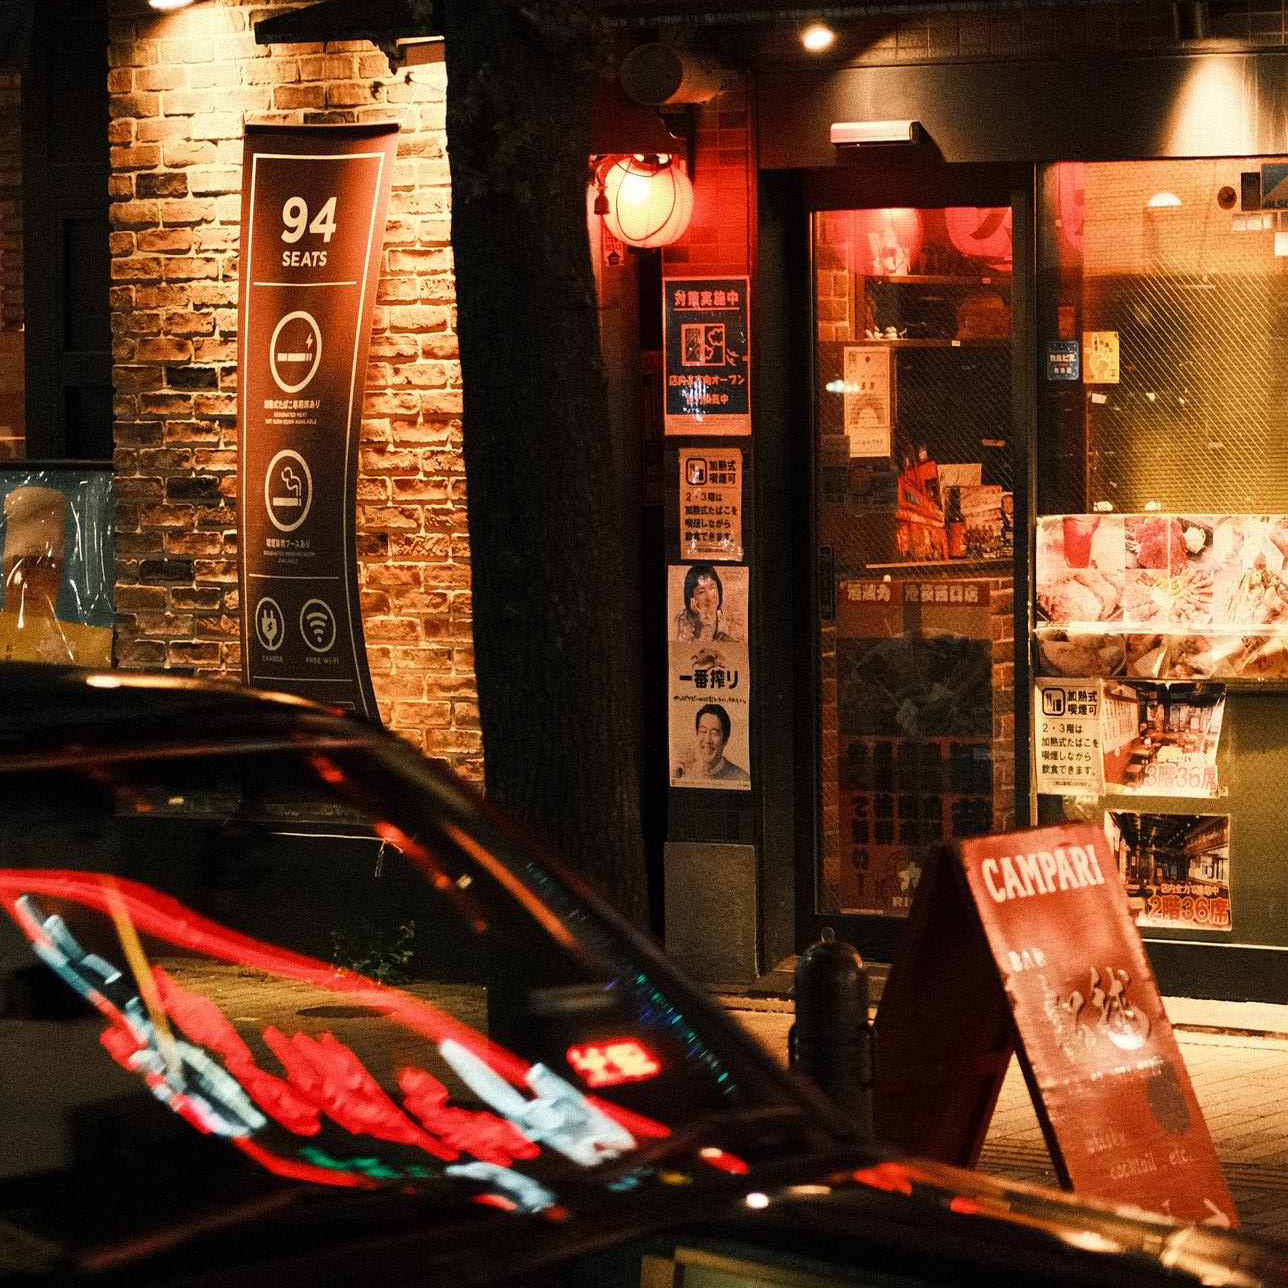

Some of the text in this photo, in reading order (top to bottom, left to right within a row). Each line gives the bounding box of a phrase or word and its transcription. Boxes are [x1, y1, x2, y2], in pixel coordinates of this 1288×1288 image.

[280, 196, 337, 244] 94
[282, 250, 328, 267] SEATS
[679, 669, 738, 690] 一番搾り
[1067, 690, 1098, 702] 加熱式
[1067, 704, 1098, 716] 喫煙可
[1041, 737, 1099, 748] 加熱式たばこを
[1041, 750, 1092, 761] 喫煙しながら
[981, 843, 1106, 903] CAMPARI
[1148, 894, 1230, 925] 2階36席
[1007, 947, 1047, 973] BAR
